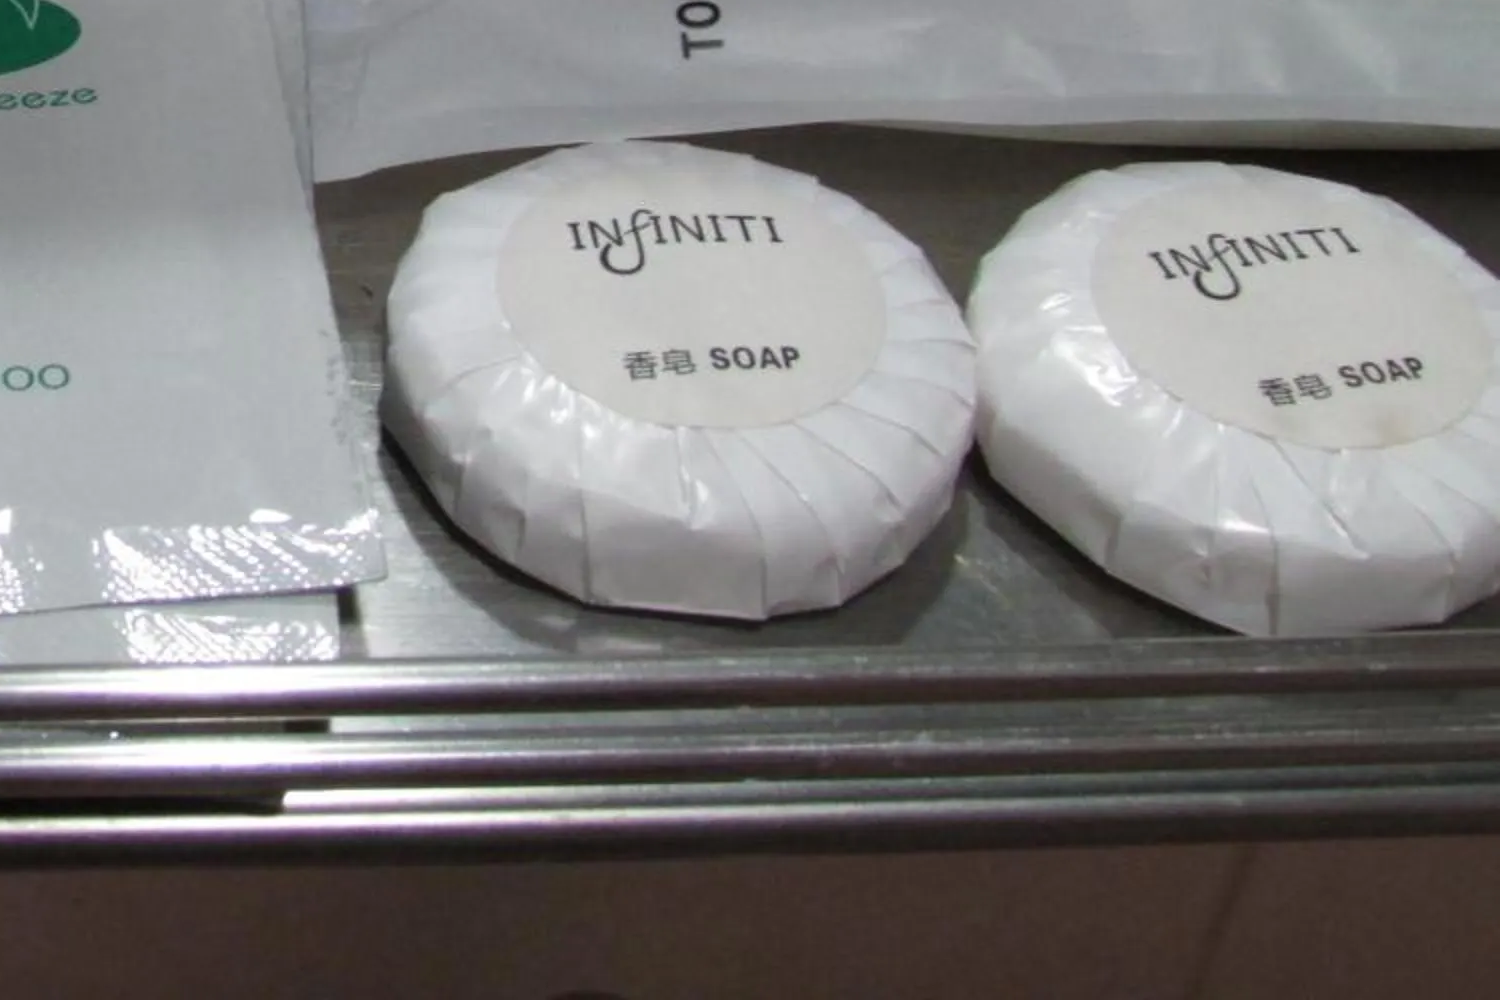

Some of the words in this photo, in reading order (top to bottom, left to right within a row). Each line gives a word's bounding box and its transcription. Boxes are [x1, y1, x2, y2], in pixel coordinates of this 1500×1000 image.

[623, 349, 697, 380] 香皂
[709, 346, 800, 371] SOAP
[1258, 374, 1333, 406] 香皂
[1337, 357, 1424, 388] SOAP
